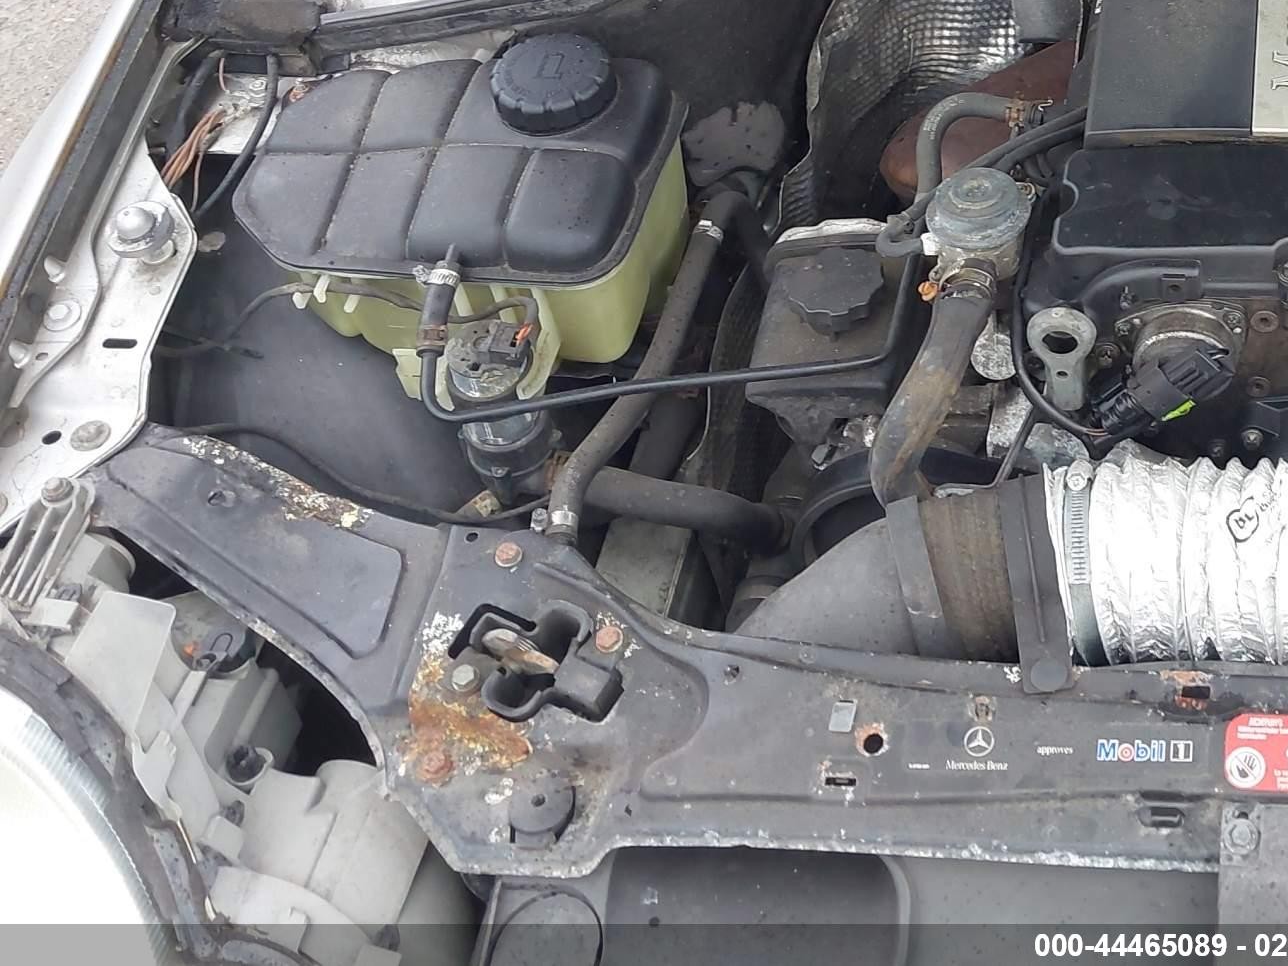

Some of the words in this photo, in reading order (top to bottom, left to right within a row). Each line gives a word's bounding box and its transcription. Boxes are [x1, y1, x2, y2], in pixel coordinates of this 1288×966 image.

[1036, 745, 1073, 757] approves
[1097, 738, 1166, 762] Mobil
[945, 759, 986, 771] Mercedes
